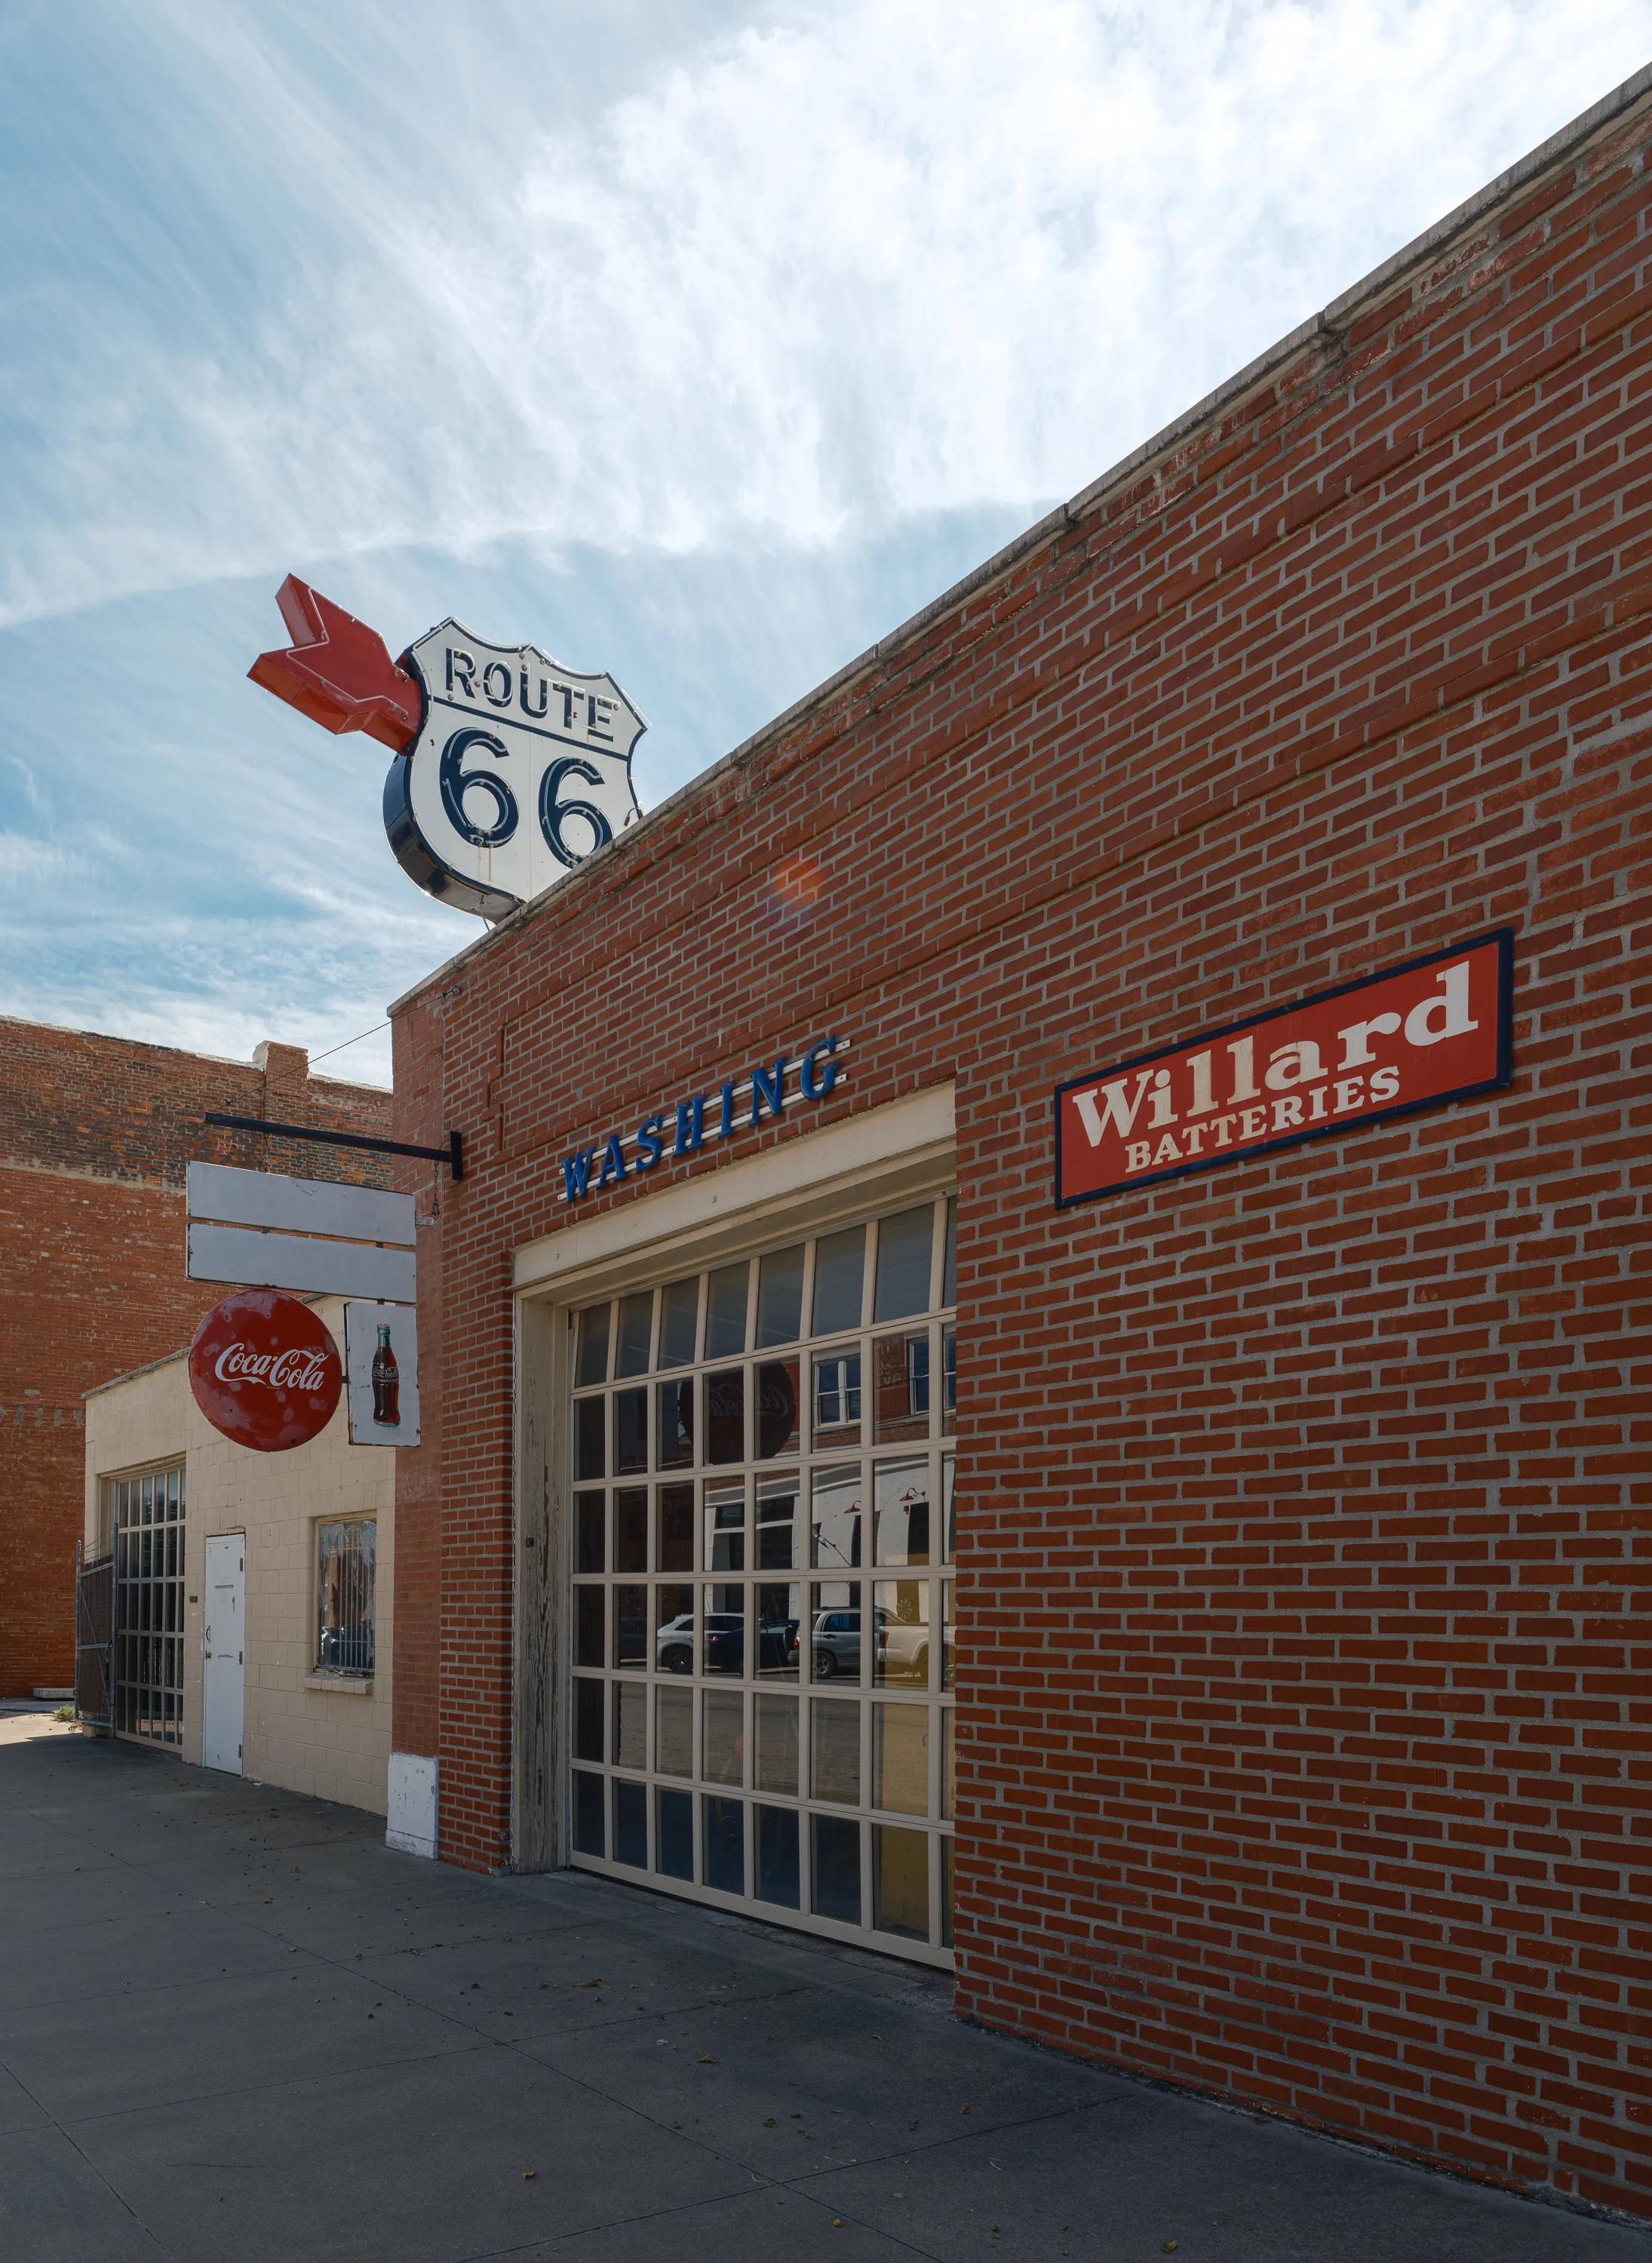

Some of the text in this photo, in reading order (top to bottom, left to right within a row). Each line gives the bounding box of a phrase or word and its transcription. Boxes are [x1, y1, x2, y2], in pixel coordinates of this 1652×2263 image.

[446, 647, 620, 742] ROUTE
[440, 727, 614, 868] 66
[1073, 961, 1479, 1147] Willard
[562, 1035, 839, 1204] WASHING
[1125, 1066, 1399, 1174] BATTERIES
[215, 1343, 329, 1390] Coca-Cola
